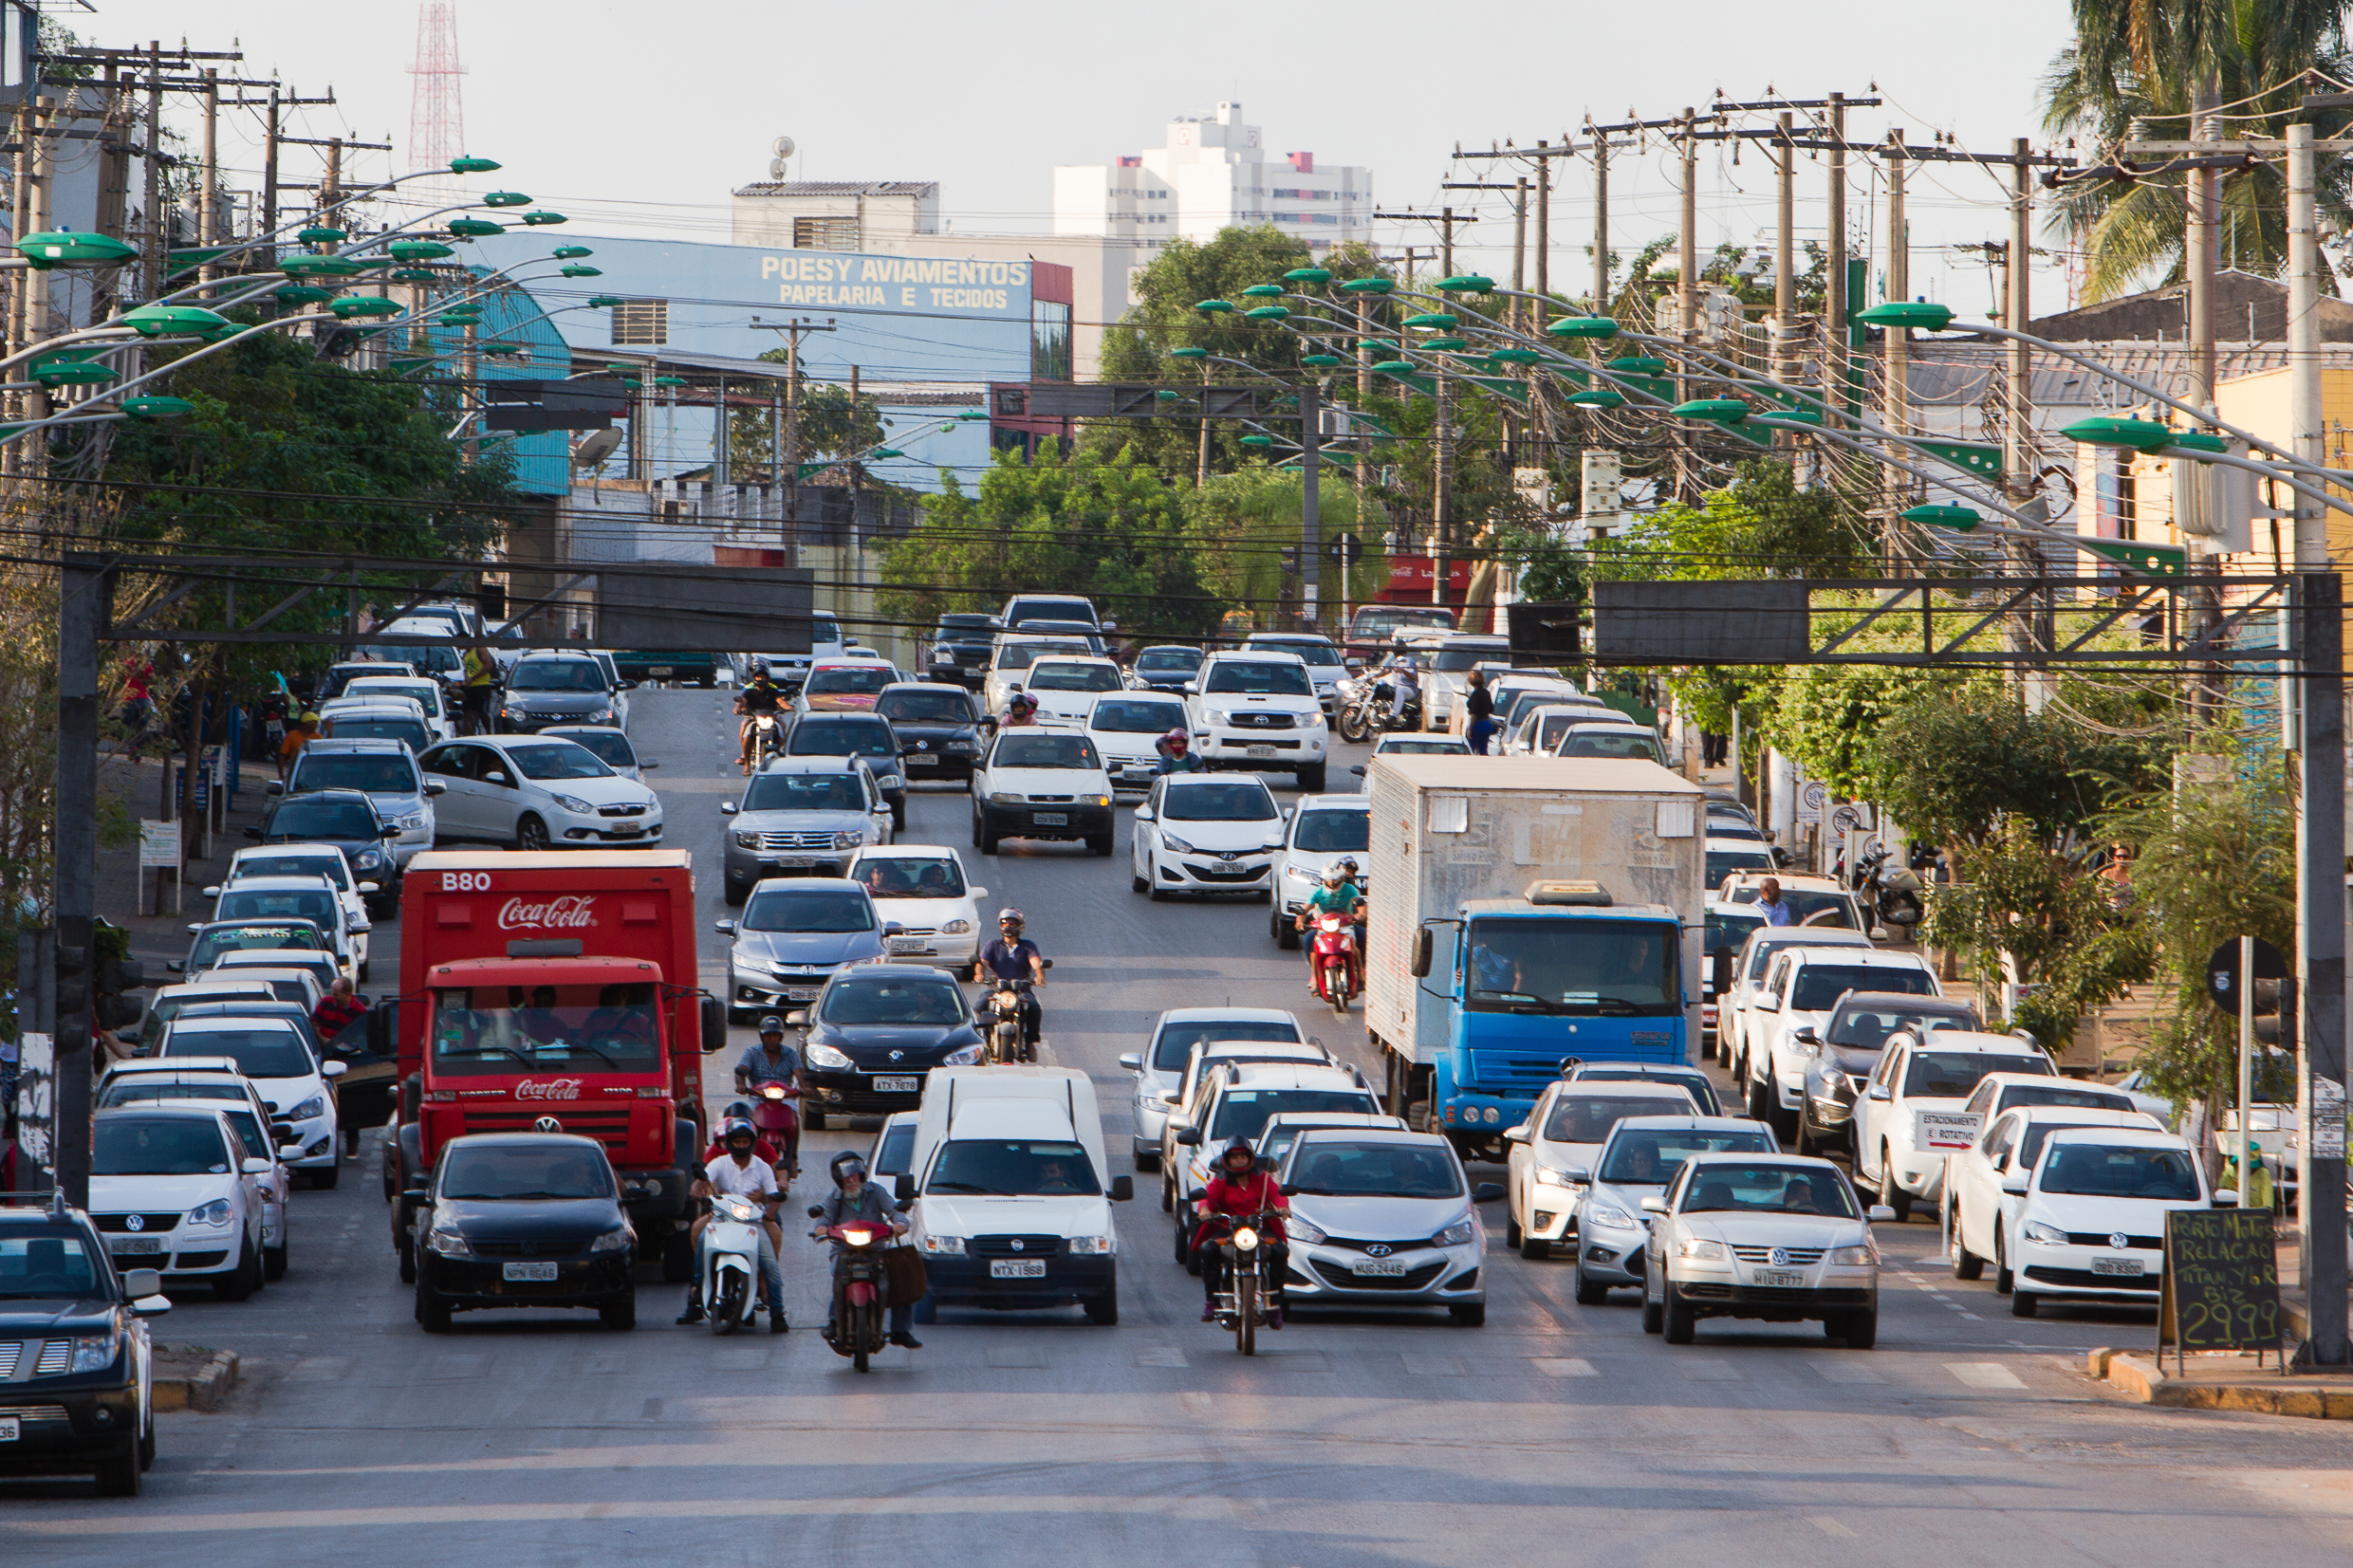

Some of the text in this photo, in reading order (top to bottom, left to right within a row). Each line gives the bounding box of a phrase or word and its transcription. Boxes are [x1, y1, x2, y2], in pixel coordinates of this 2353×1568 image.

[762, 256, 1027, 286] POESY AVIAMENTOS
[780, 285, 1009, 309] PAPELARIA E TECIDOS
[442, 873, 491, 891] B80
[497, 896, 598, 931] Coca-Cola
[515, 1079, 584, 1100] Coca-Cola
[1923, 1115, 1978, 1127] ESTACIONAMENTO
[1939, 1129, 1974, 1141] ROTATIVO
